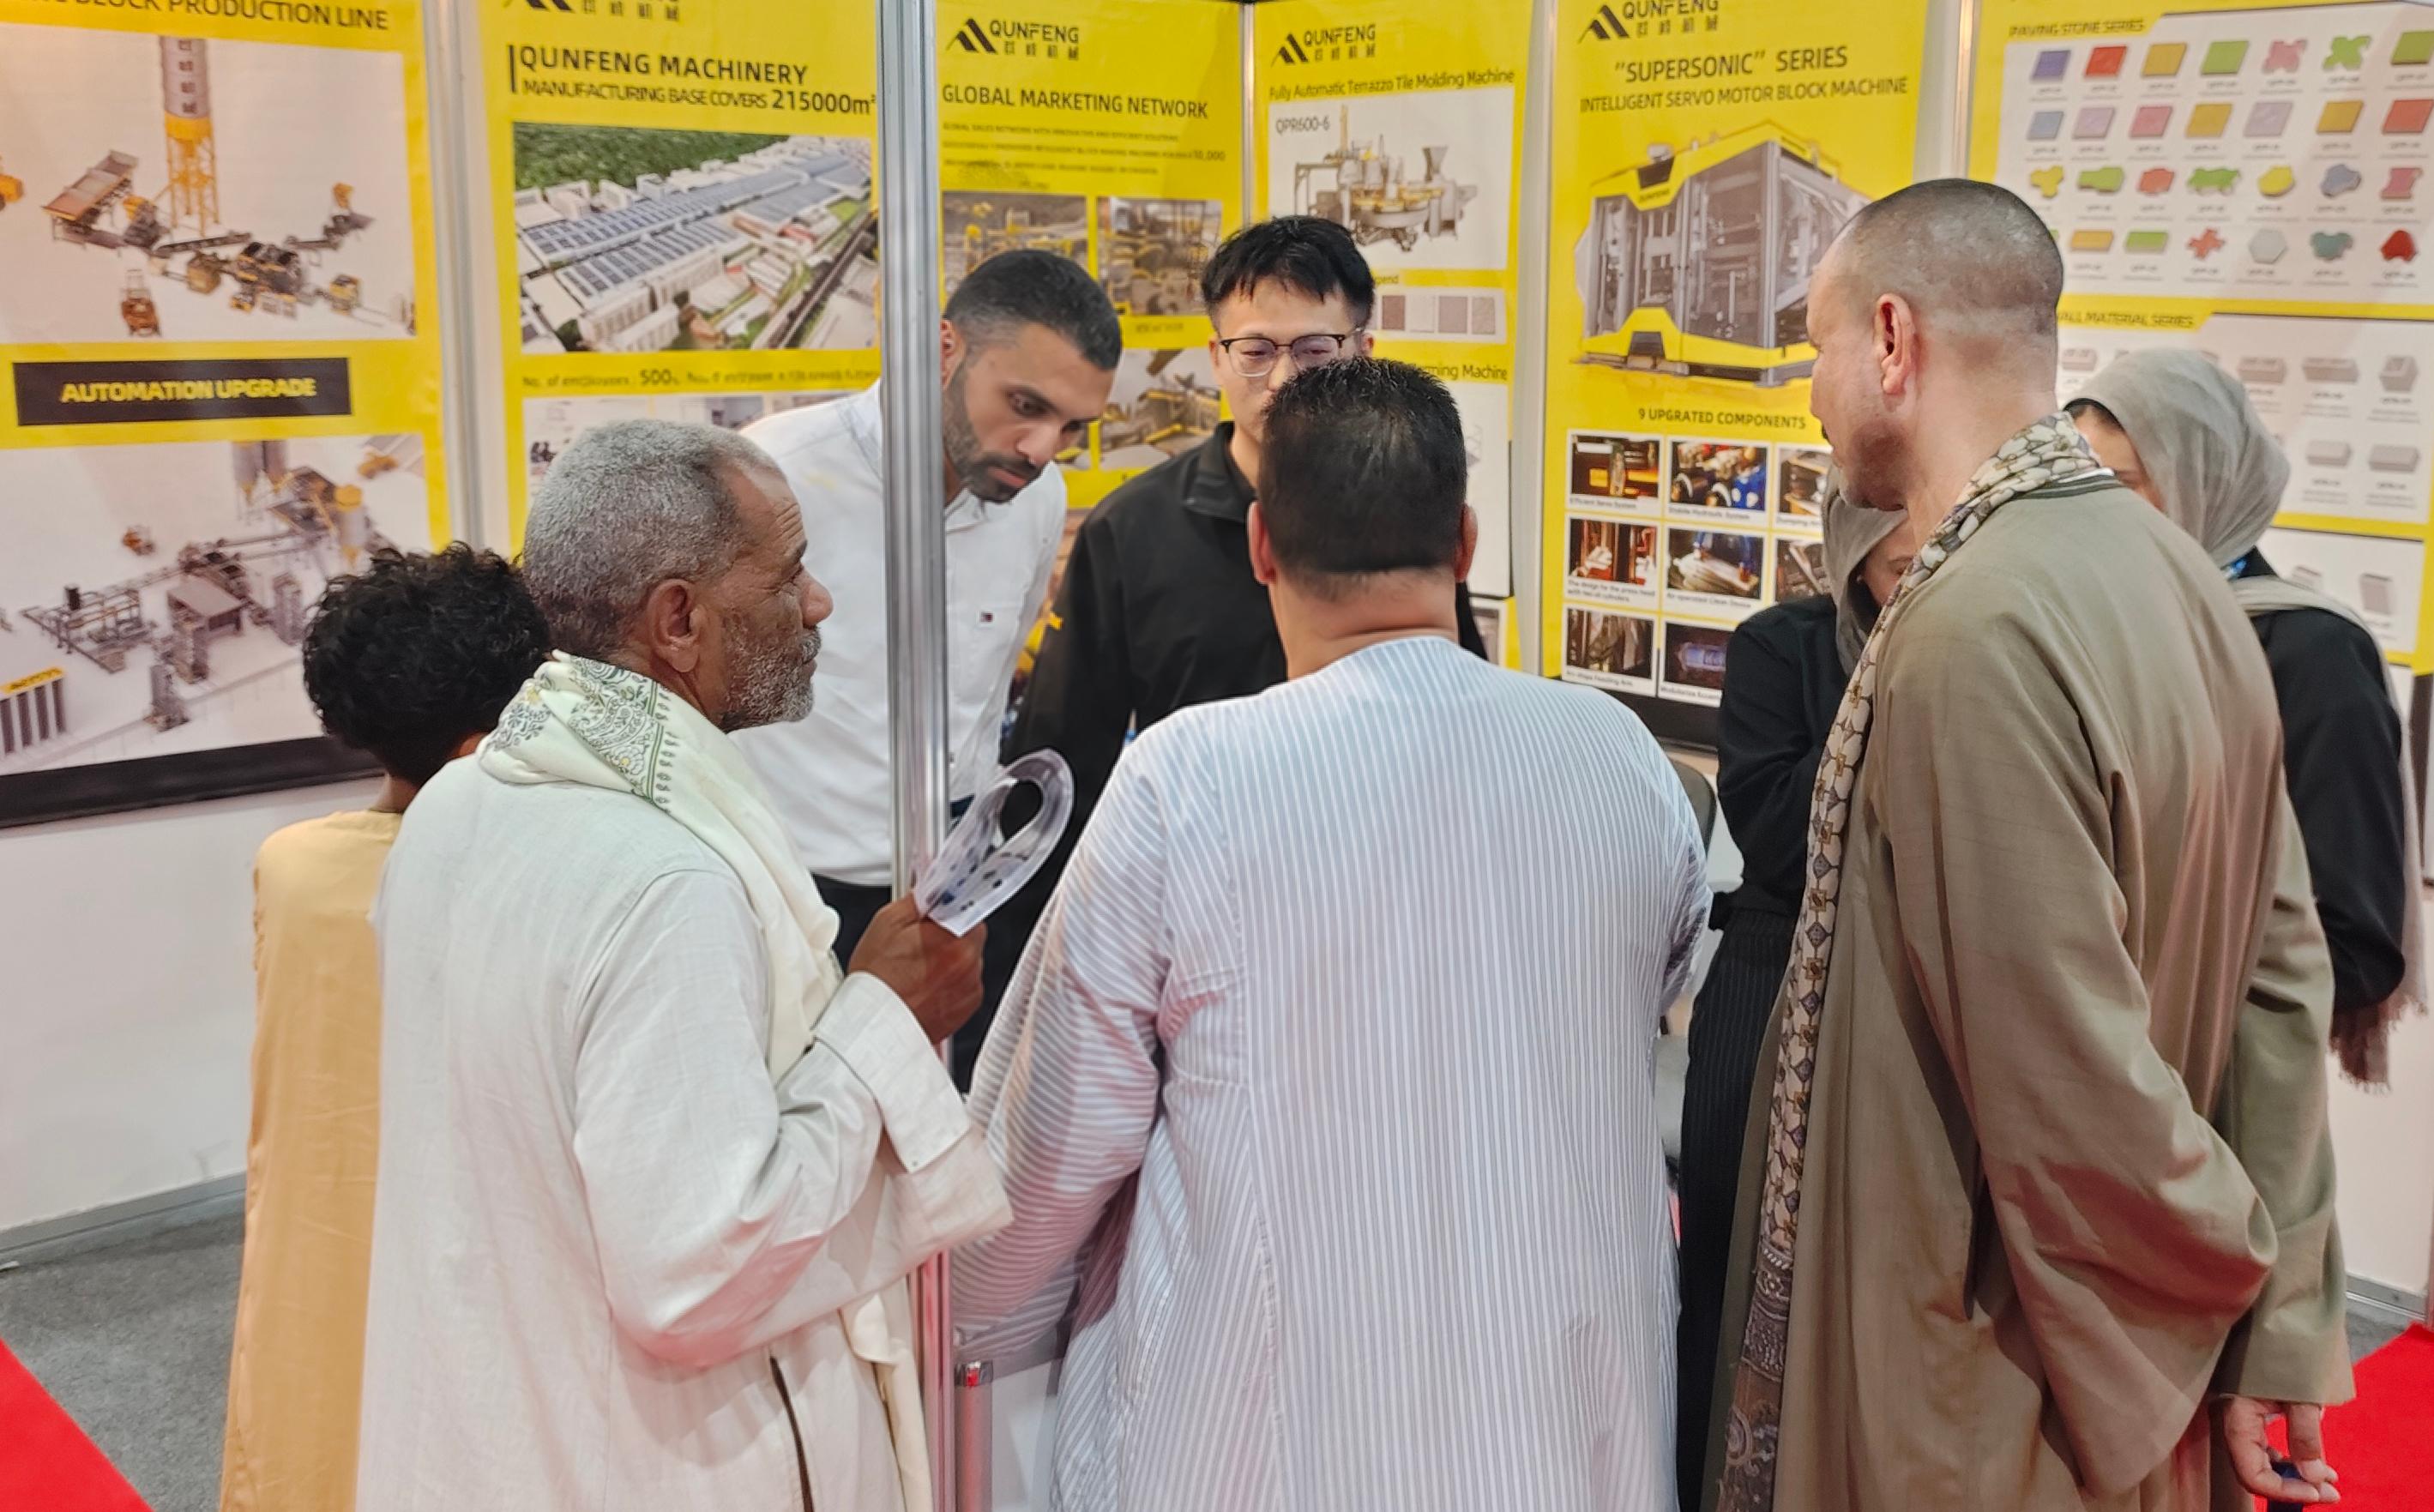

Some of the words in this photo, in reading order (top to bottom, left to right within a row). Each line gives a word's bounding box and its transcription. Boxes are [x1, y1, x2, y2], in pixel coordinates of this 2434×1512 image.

[168, 0, 330, 25] PRODUCTION
[335, 7, 389, 30] LINE
[1623, 0, 1718, 20] QUNFENG
[989, 19, 1080, 44] QUNFENG
[1304, 23, 1377, 46] QUNFENG
[519, 45, 650, 75] QUNFENG
[659, 54, 809, 85] MACHINERY
[1775, 45, 1848, 73] SERIES
[523, 79, 666, 103] MANUFACTURING
[668, 87, 708, 105] BASE
[709, 88, 768, 109] COVERS
[1269, 83, 1292, 102] Fully
[1293, 81, 1346, 99] Automatic
[1395, 74, 1414, 90] Tile
[1415, 70, 1464, 90] Molding
[1467, 66, 1515, 85] Machine
[1580, 92, 1663, 113] INTELLIGENT
[1666, 88, 1714, 108] SERVO
[1717, 85, 1774, 105] MOTOR
[1775, 81, 1828, 101] BLOCK
[1829, 75, 1907, 98] MACHINE
[942, 83, 1016, 107] GLOBAL
[1020, 88, 1123, 114] MARKETING
[1127, 95, 1209, 120] NETWORK
[1461, 364, 1508, 381] Machine
[60, 380, 214, 403] AUTOMATION
[215, 377, 317, 398] UPGRADE
[1638, 407, 1646, 420] 9
[1648, 407, 1714, 425] UPGRATED
[1716, 411, 1807, 431] COMPONENTS
